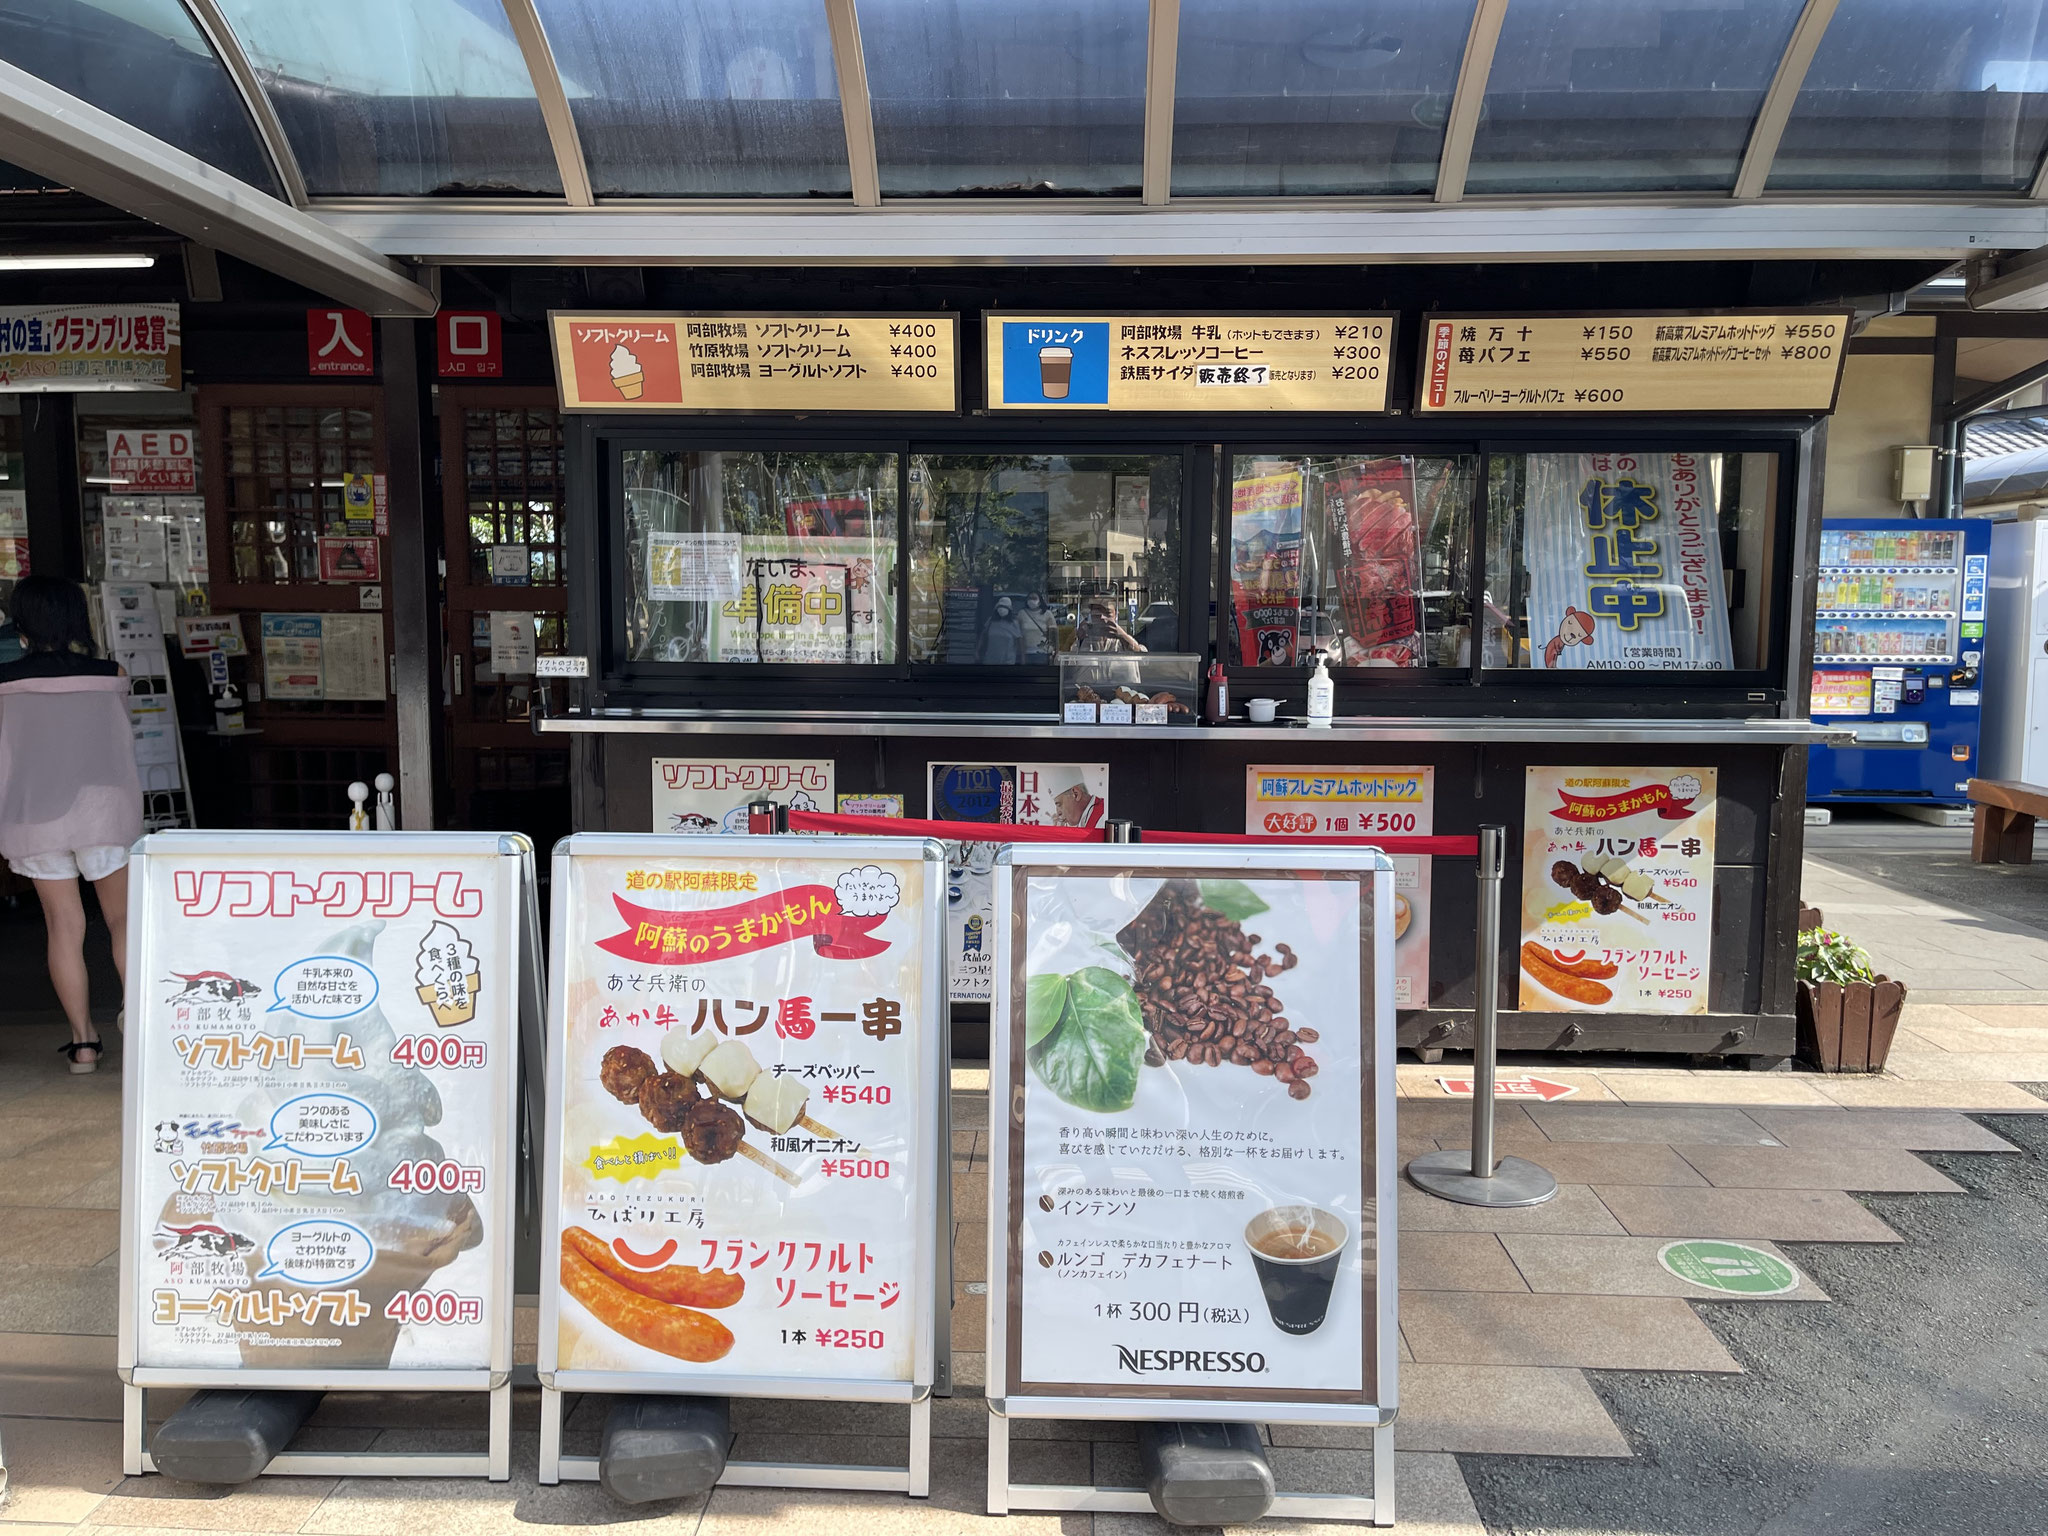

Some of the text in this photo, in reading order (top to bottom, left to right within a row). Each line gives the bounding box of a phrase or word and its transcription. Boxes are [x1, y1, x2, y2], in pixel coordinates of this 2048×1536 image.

[318, 313, 364, 357] 入
[450, 316, 488, 355] 口
[577, 329, 669, 344] ソフトクリーム
[687, 323, 936, 339] 阿部牧場 ソフトクリーム ¥400
[1027, 329, 1083, 344] ドリンク
[1121, 325, 1383, 341] 阿部牧場 牛乳 (ホットもできます) ¥210
[1583, 326, 1633, 339] ¥150
[1785, 325, 1835, 338] ¥550
[689, 344, 936, 359] 竹原牧場 ソフトクリーム ¥400
[1121, 347, 1381, 359] ネスプレッソコーヒー ¥300
[1459, 347, 1630, 363] 苺パフェ ¥550
[1781, 346, 1831, 359] ¥800
[318, 362, 364, 371] entrance
[477, 363, 496, 372] 입구
[691, 363, 937, 379] 阿部牧場 ヨーグルトソフト ¥400
[1437, 325, 1447, 404] 季節のメニュー
[1199, 368, 1267, 384] 販売終了
[1332, 367, 1379, 379] ¥200
[1454, 389, 1623, 403] ブルーベリーヨーグルトパフェ ¥600
[113, 434, 188, 455] AED
[1579, 477, 1664, 631] 休止中
[744, 557, 816, 578] だいま、
[722, 583, 842, 624] 準備中
[1624, 647, 1682, 658] 【営業時間】
[663, 765, 827, 790] ソフトクリーム
[1565, 778, 1630, 788] 道の駅阿蘇限定
[1262, 778, 1417, 797] 阿蘇プレミアムホットドッグ
[959, 795, 992, 808] 2012
[1569, 788, 1667, 818] 阿蘇のうまかもん
[1267, 813, 1416, 832] 大好評 1個 ¥500
[1554, 827, 1604, 836] あそ兵衛の
[626, 871, 757, 891] 道の駅阿蘇限定
[1663, 879, 1697, 888] ¥540
[174, 871, 483, 917] ソフトクリーム
[634, 895, 832, 955] 阿蘇のうまかもん
[1662, 913, 1696, 921] ¥500
[963, 953, 991, 962] 食品の
[1601, 949, 1688, 965] フランクフルト
[302, 967, 353, 979] 牛乳本来の
[428, 948, 451, 1010] 食べくらべ
[446, 943, 468, 1009] 3種の味を
[1639, 966, 1701, 981] ソーセージ
[297, 980, 357, 992] 自然な甘さを
[608, 974, 705, 993] あそ兵衛の
[291, 993, 363, 1005] 活かした味です
[1659, 990, 1691, 998] ¥250
[177, 1008, 252, 1021] 阿部牧場
[600, 1004, 679, 1031] あか牛
[175, 1034, 485, 1070] ソフトクリーム 400円
[772, 1064, 874, 1080] チーズペッパー
[823, 1086, 891, 1105] ¥540
[299, 1105, 350, 1116] コクのある
[299, 1118, 350, 1130] 美味しさに
[284, 1131, 365, 1143] こだわっています
[1059, 1126, 1276, 1143] 香り高い瞬間と味わい深い人生のために。
[771, 1137, 860, 1153] 和風オニオン
[1059, 1142, 1347, 1161] 喜びを感じていただける、格別な一杯をお届けします。
[172, 1160, 484, 1194] ソフトクリーム 400円
[821, 1159, 889, 1179] ¥500
[1058, 1187, 1245, 1200] 深みのある味わいと最後の一口まで続く焙煎香
[1059, 1201, 1136, 1216] インテンソ
[588, 1206, 705, 1229] ひばり工房
[291, 1231, 350, 1243] ヨーグルトの
[1057, 1239, 1232, 1250] カフェインレスで柔らかな口当たりと豊かなアロマ
[296, 1245, 346, 1256] さわやかな
[701, 1240, 873, 1273] フランクフルト
[170, 1262, 245, 1275] 阿部牧場
[284, 1258, 356, 1269] 後味が特徴です
[1057, 1252, 1232, 1270] ルンゴ デカフェナート
[1057, 1269, 1127, 1280] (ノンカフェイン)
[776, 1277, 900, 1310] ソーセージ
[154, 1290, 482, 1325] ヨーグルトソフト 400円
[781, 1329, 884, 1349] 1本 ¥250
[1112, 1344, 1266, 1374] NESPRESSO
